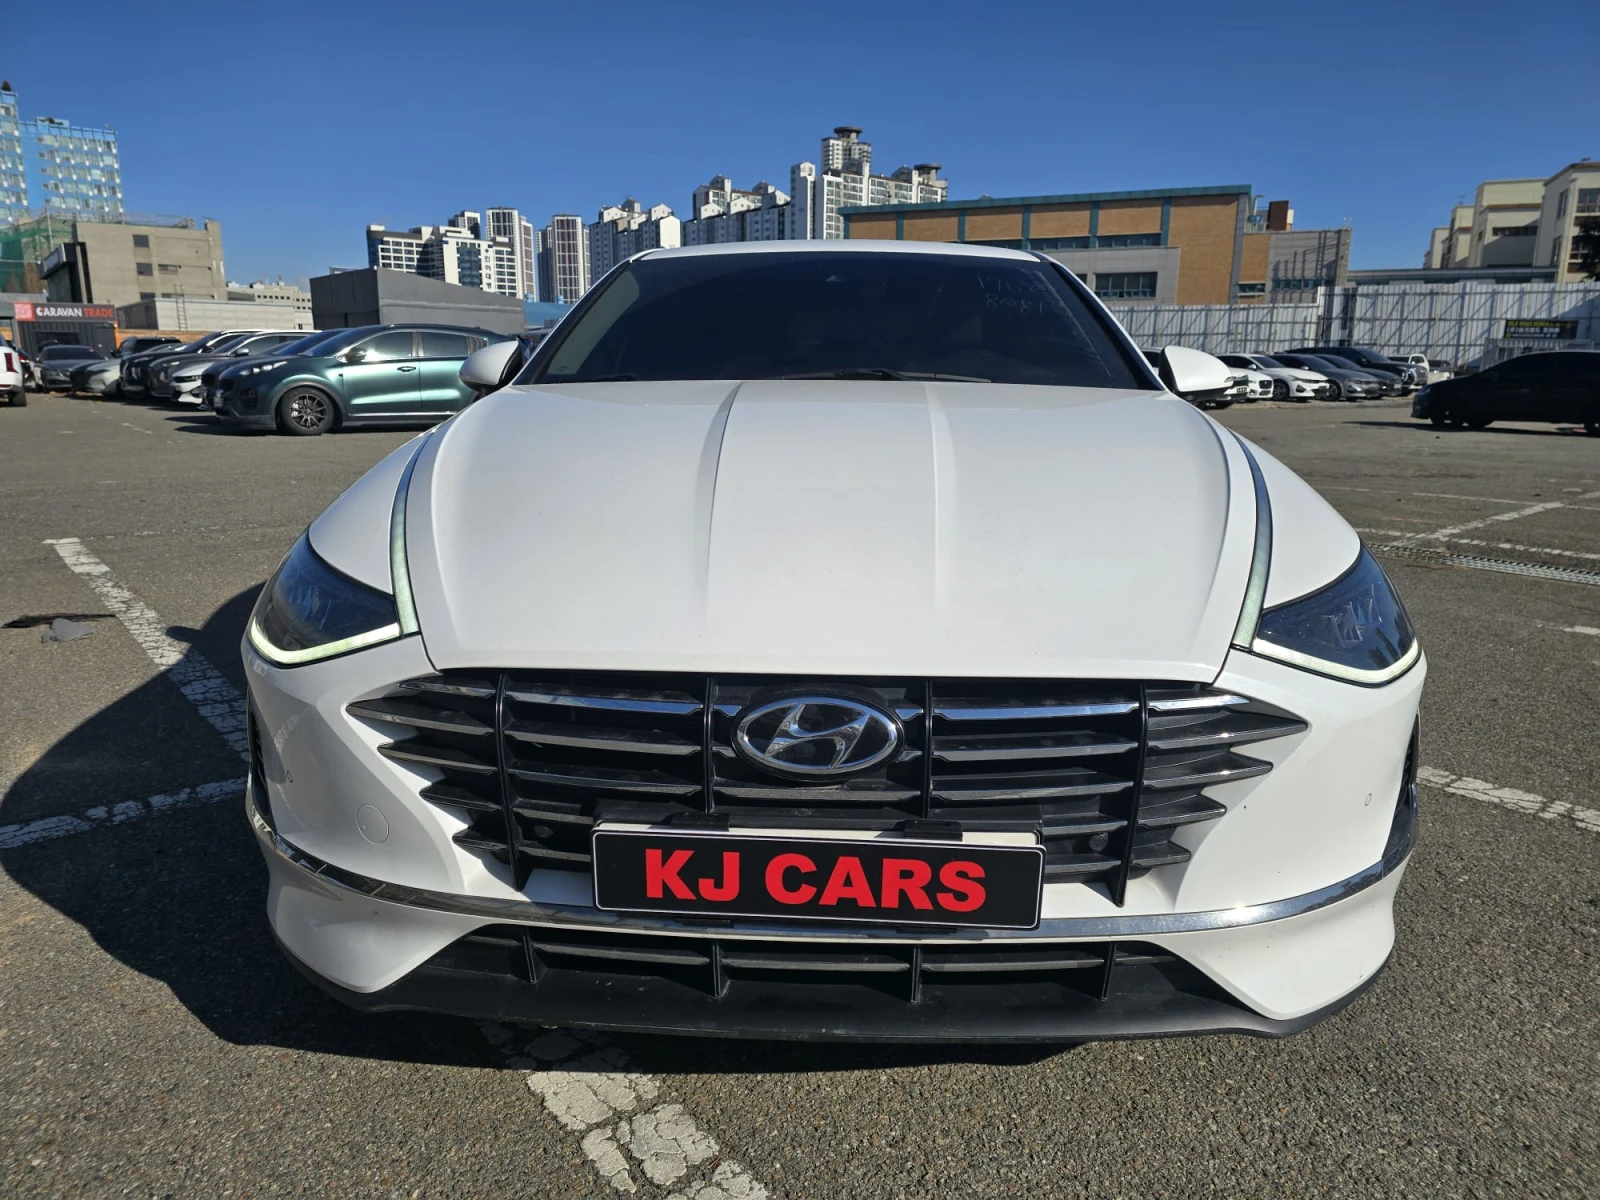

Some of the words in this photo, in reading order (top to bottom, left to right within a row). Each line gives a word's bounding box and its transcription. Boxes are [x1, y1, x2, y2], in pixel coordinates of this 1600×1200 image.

[36, 307, 82, 317] CARAVAN
[84, 308, 113, 317] TRADE
[645, 848, 740, 902] KJ
[765, 852, 987, 913] CARS
